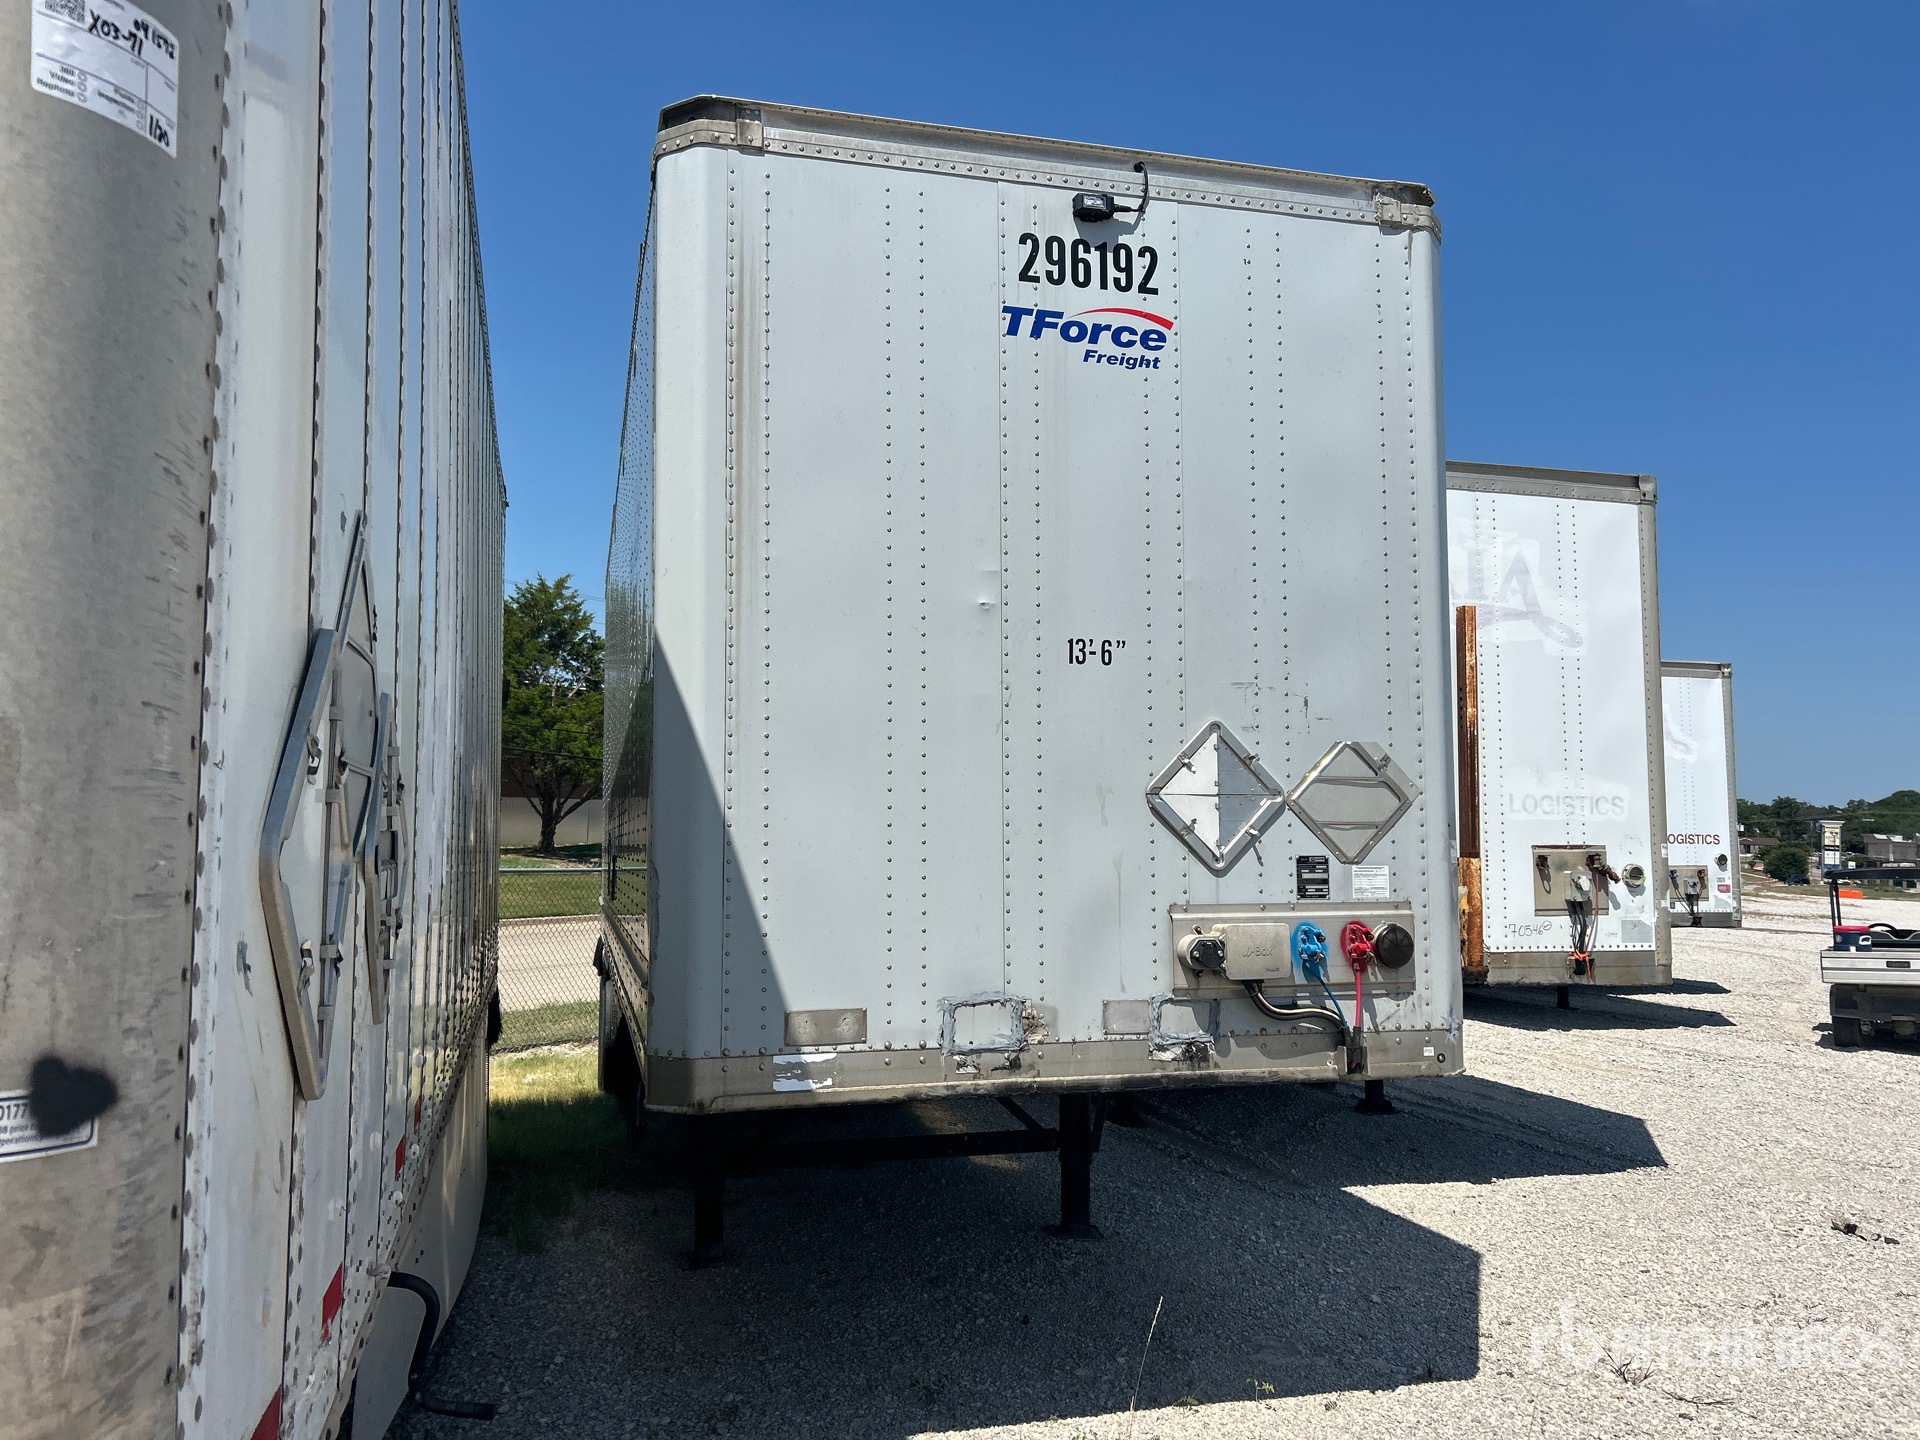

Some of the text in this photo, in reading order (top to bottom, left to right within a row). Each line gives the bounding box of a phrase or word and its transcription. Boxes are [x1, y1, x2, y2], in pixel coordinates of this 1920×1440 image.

[1018, 232, 1159, 295] 296192
[1001, 305, 1168, 351] TForce
[1083, 349, 1161, 370] Freight
[1508, 793, 1625, 816] LOGISTICS
